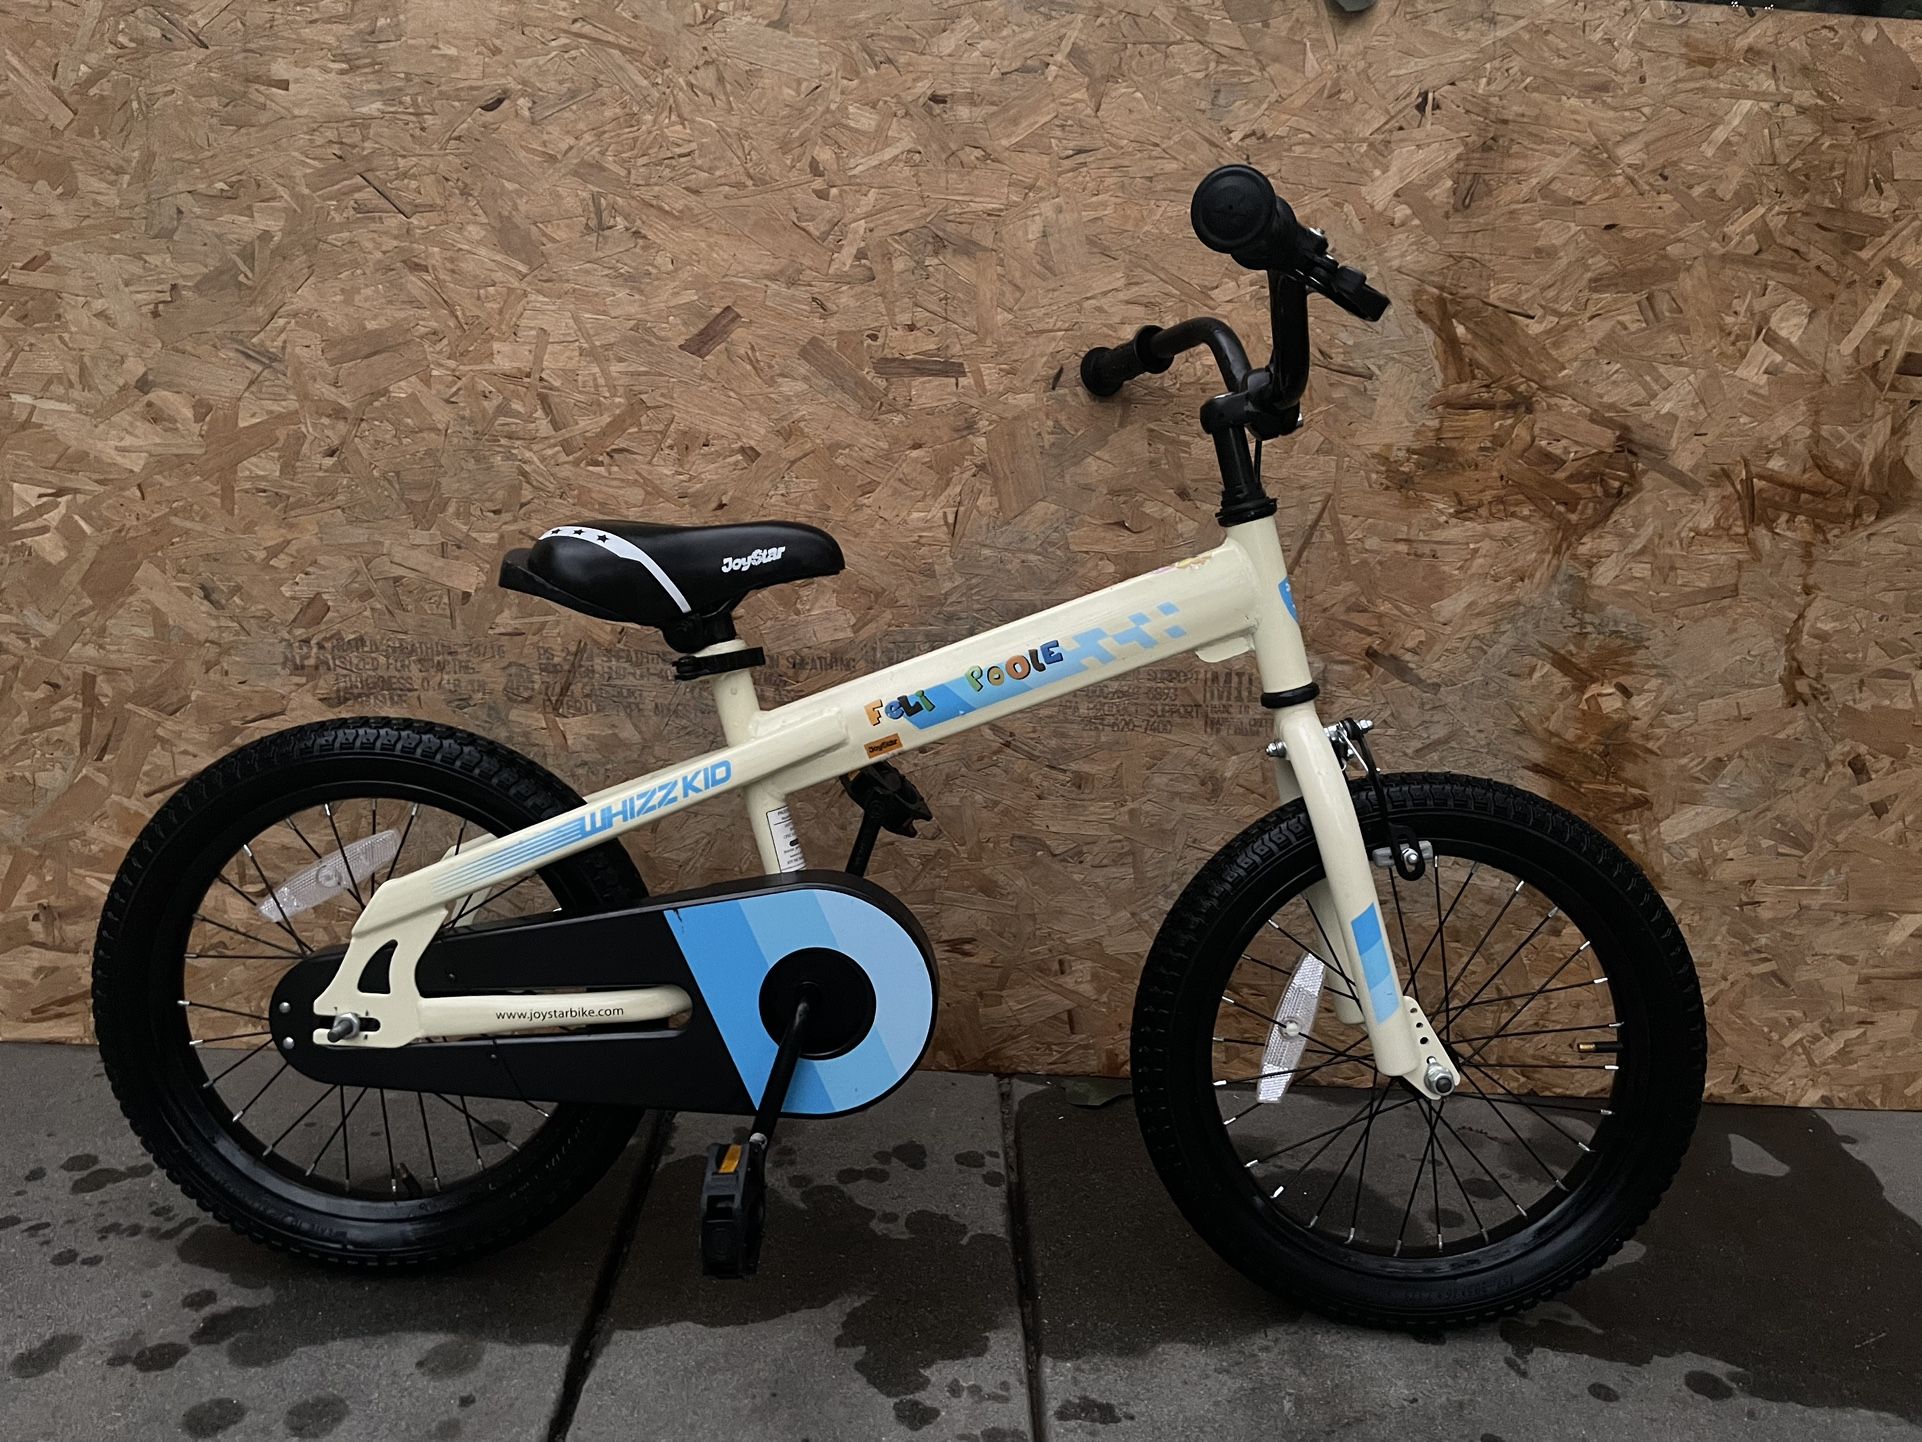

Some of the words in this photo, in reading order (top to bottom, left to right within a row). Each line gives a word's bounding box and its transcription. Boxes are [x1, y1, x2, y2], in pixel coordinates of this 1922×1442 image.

[722, 546, 786, 573] JoyStar
[1147, 703, 1202, 719] SUPPORT
[496, 1007, 624, 1021] www.joystarbike.com
